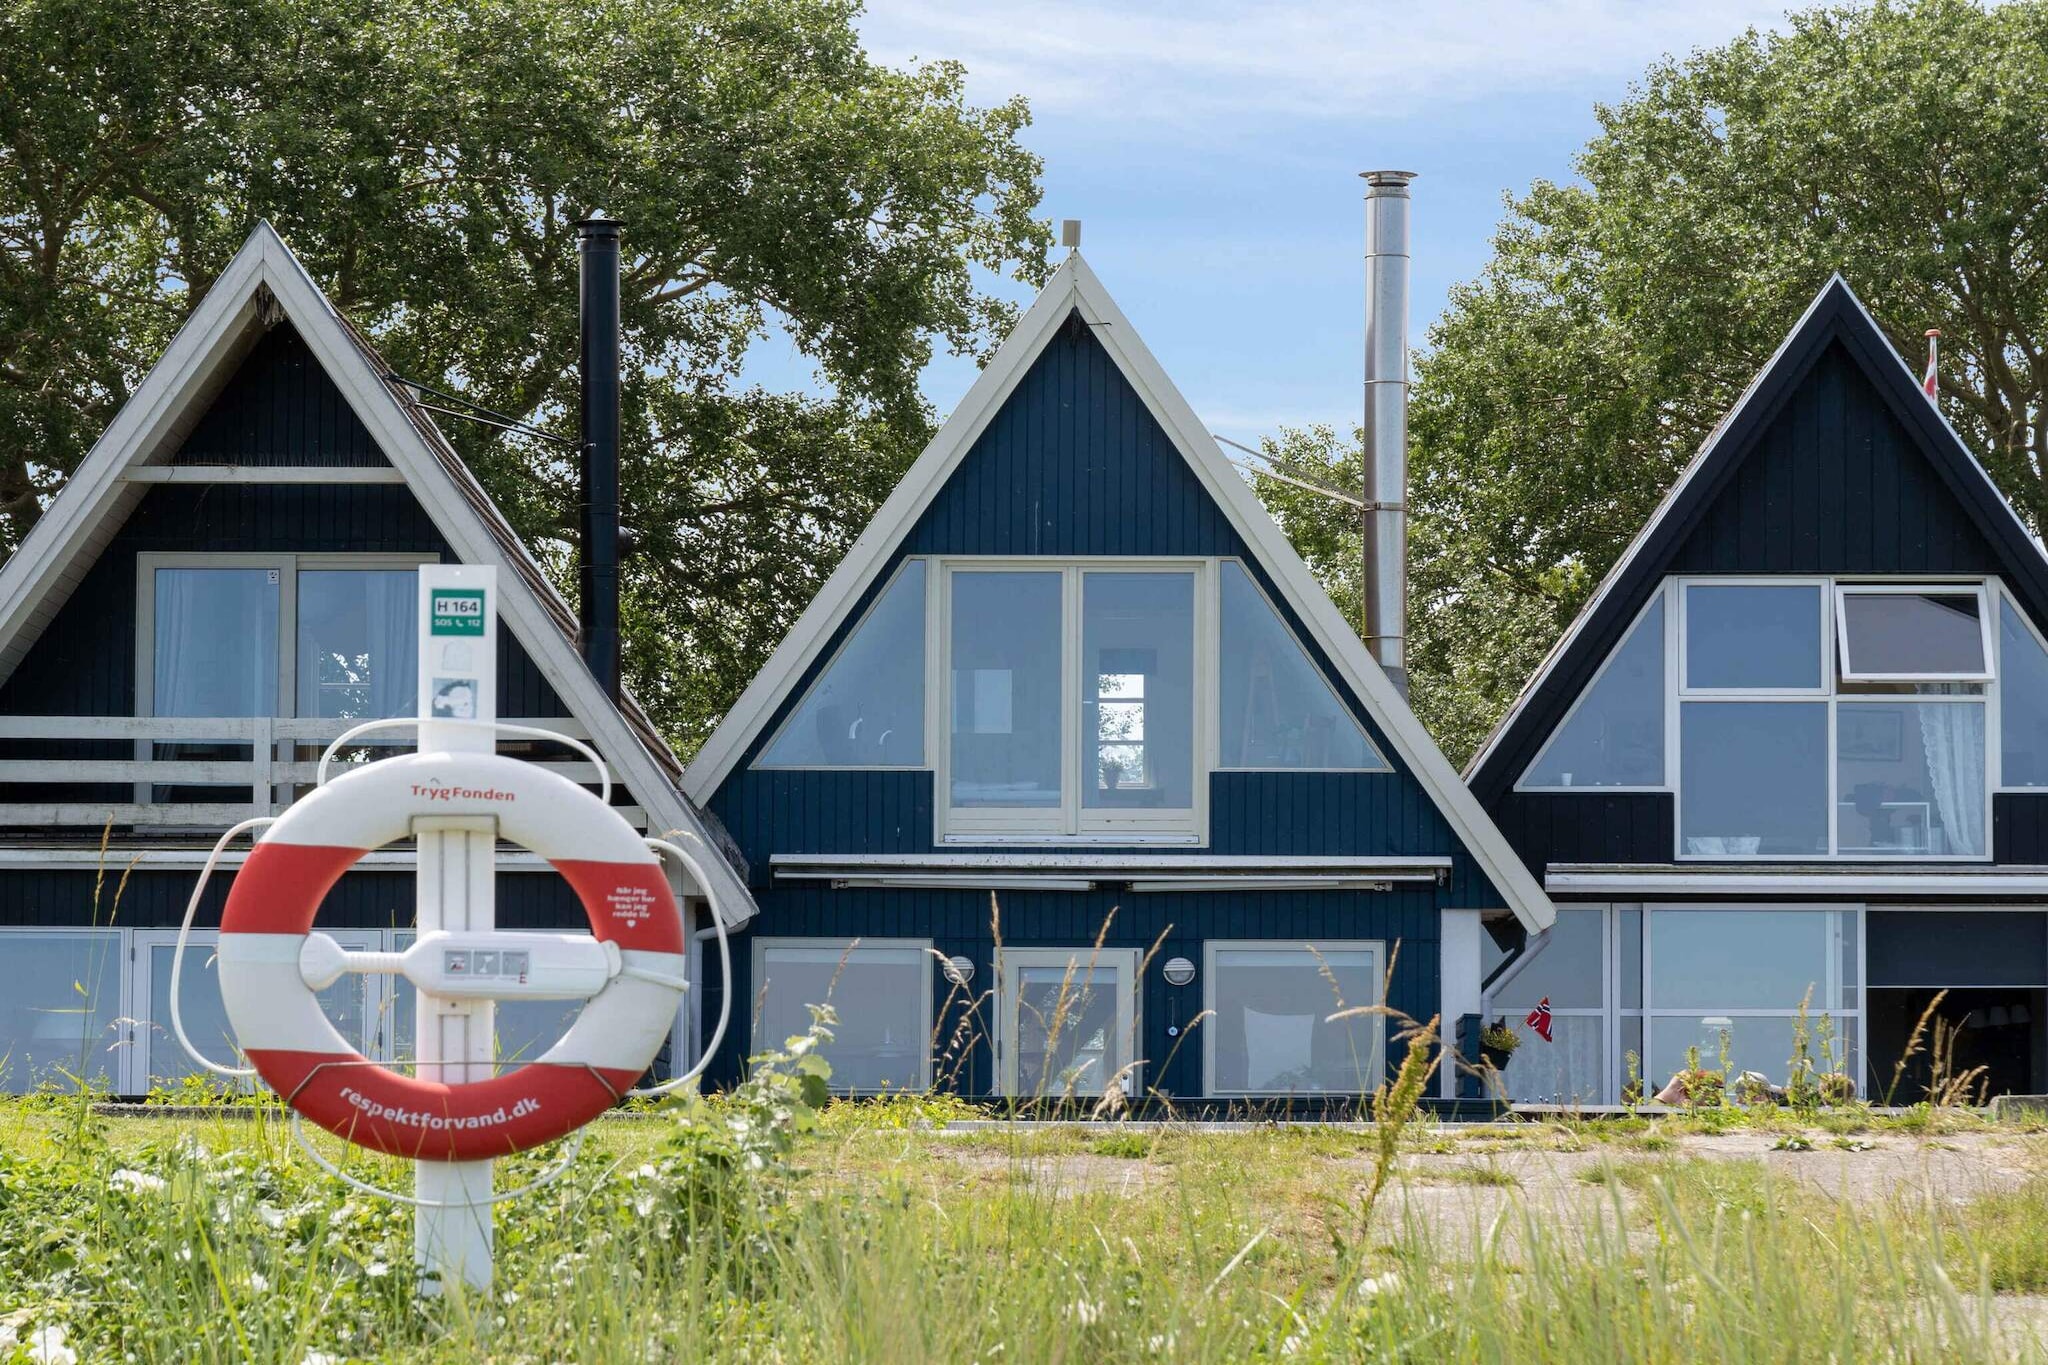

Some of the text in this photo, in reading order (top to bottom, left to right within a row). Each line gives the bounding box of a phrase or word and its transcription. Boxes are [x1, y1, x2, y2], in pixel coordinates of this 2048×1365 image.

[437, 601, 478, 613] H 164
[434, 618, 481, 627] SOS 112
[410, 785, 516, 802] TrygFonden
[339, 1086, 541, 1130] respektforvand.dk
